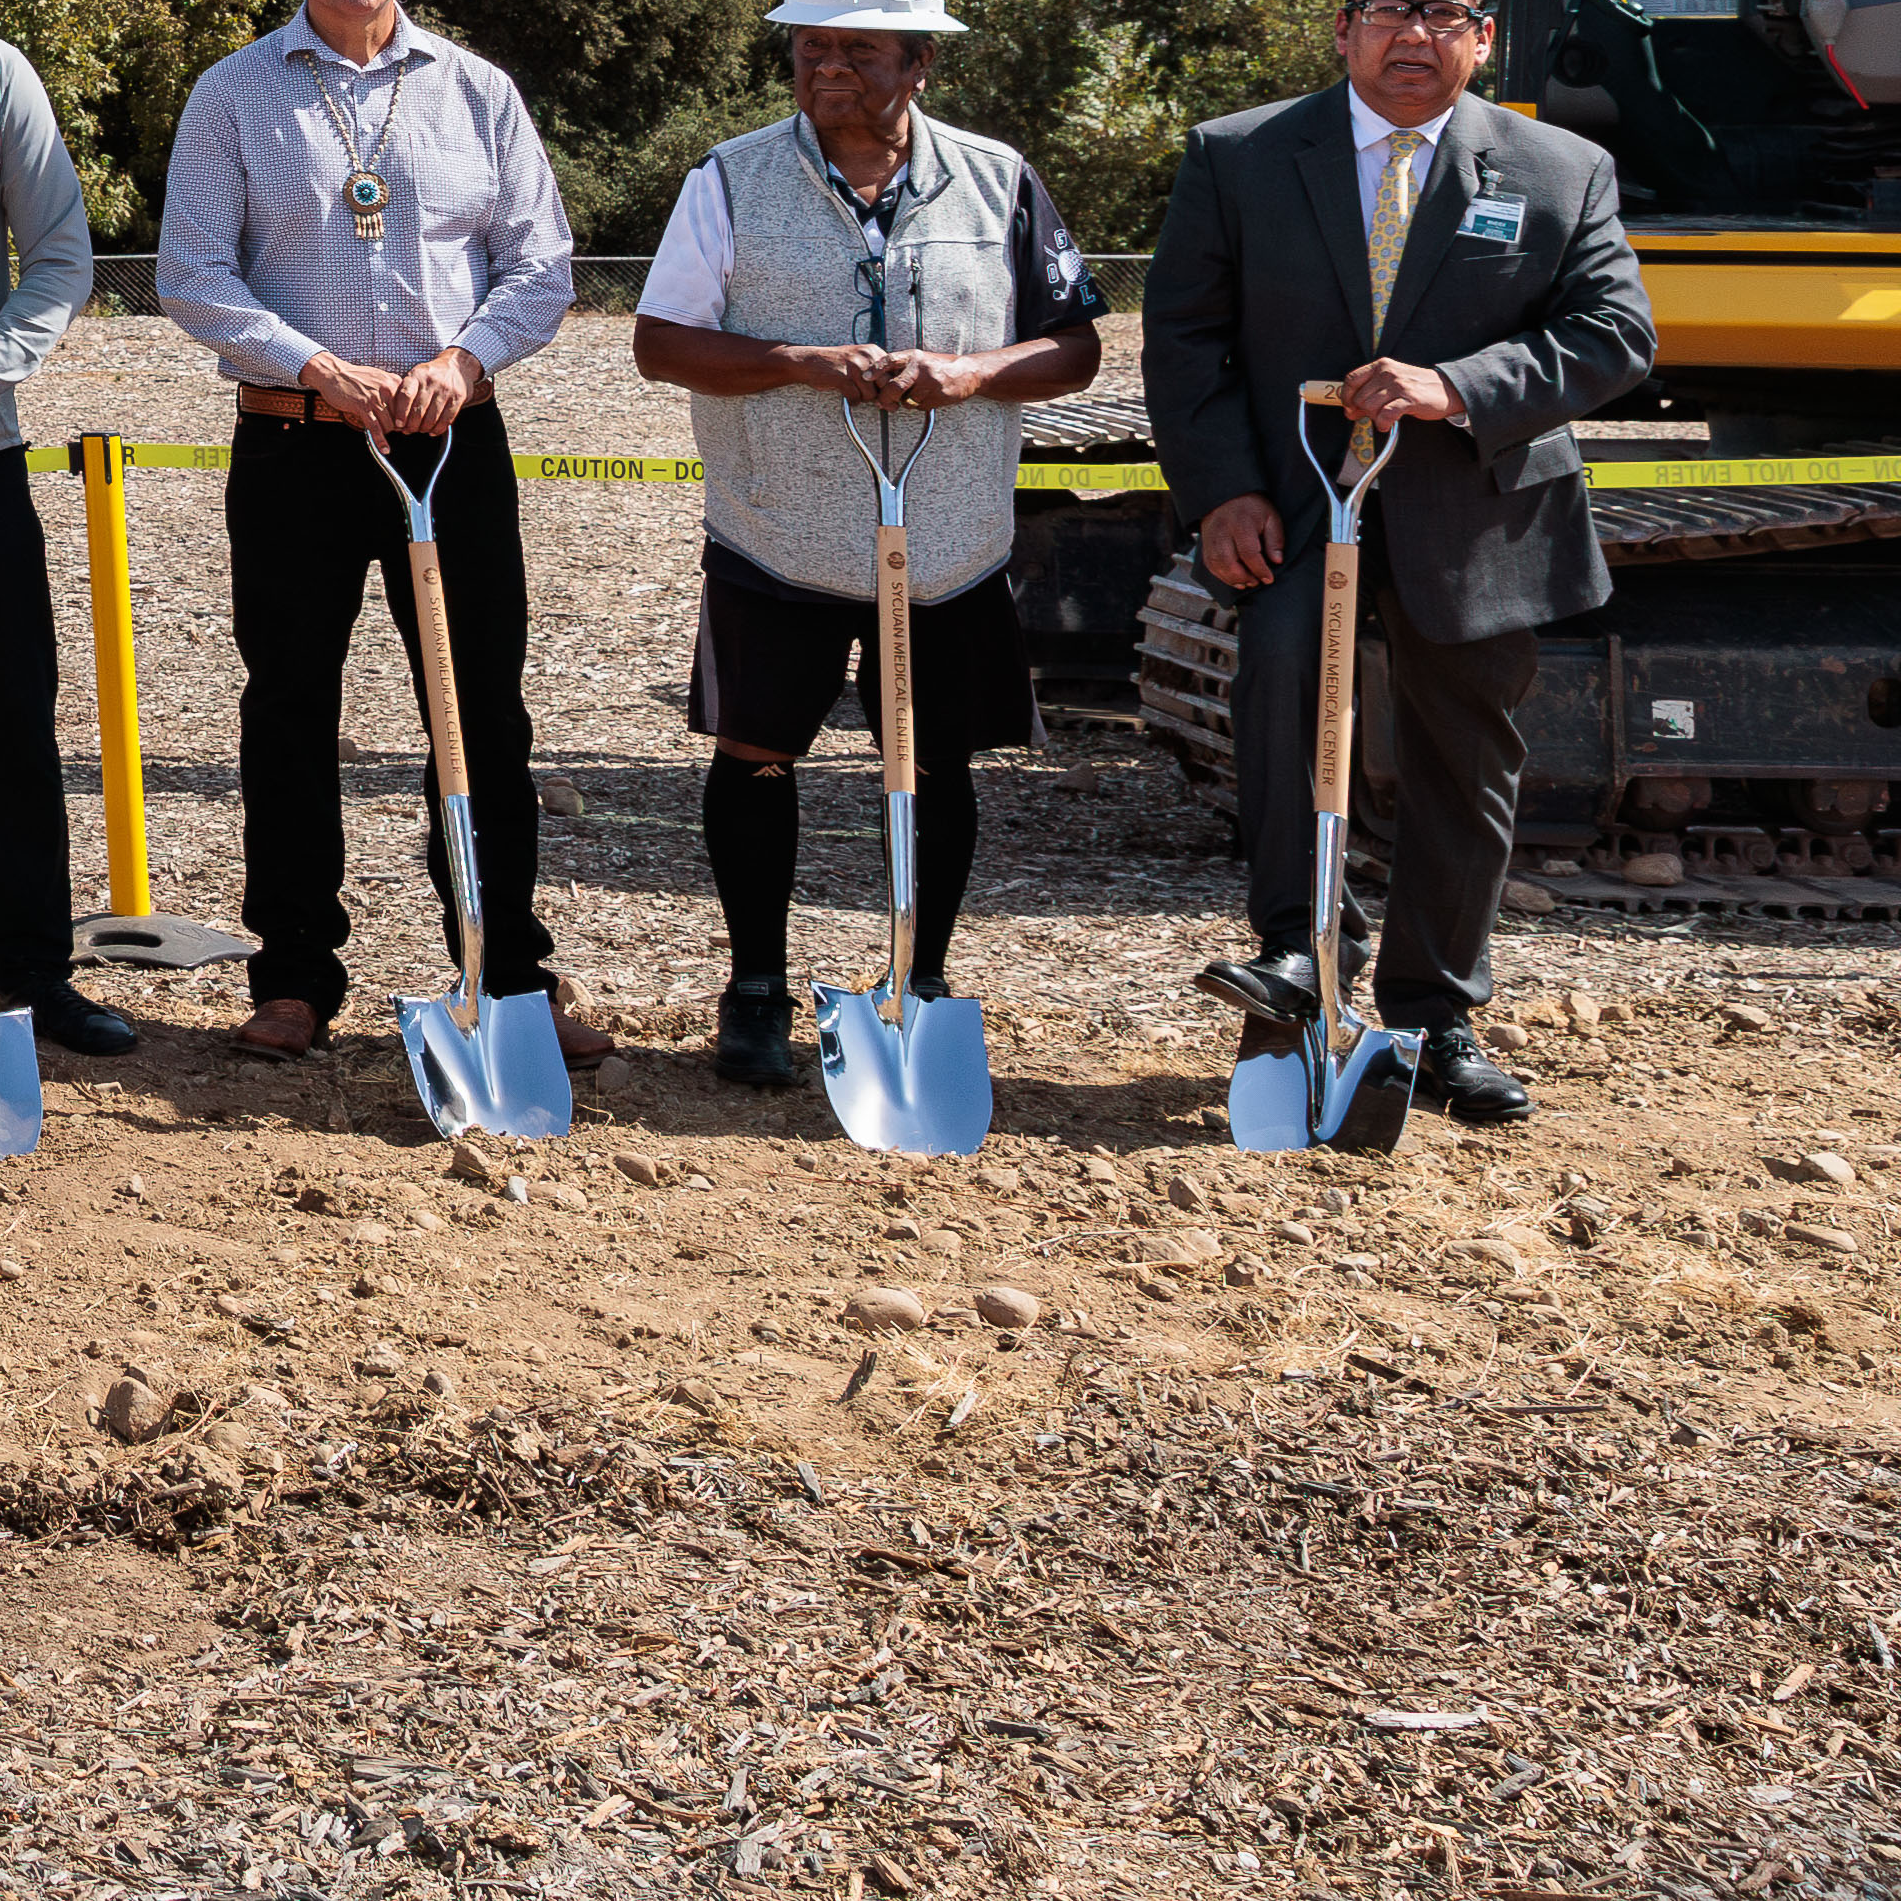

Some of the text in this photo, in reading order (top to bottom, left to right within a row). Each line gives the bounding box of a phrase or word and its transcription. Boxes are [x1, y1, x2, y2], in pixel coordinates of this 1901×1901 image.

[541, 458, 705, 480] CAUTION DO
[430, 597, 463, 775] SYCUAN MEDICAL CENTER
[891, 582, 909, 762] SYCUAN MEDICAL CENTER
[1322, 601, 1342, 786] SYCUAN MEDICAL CENTER
